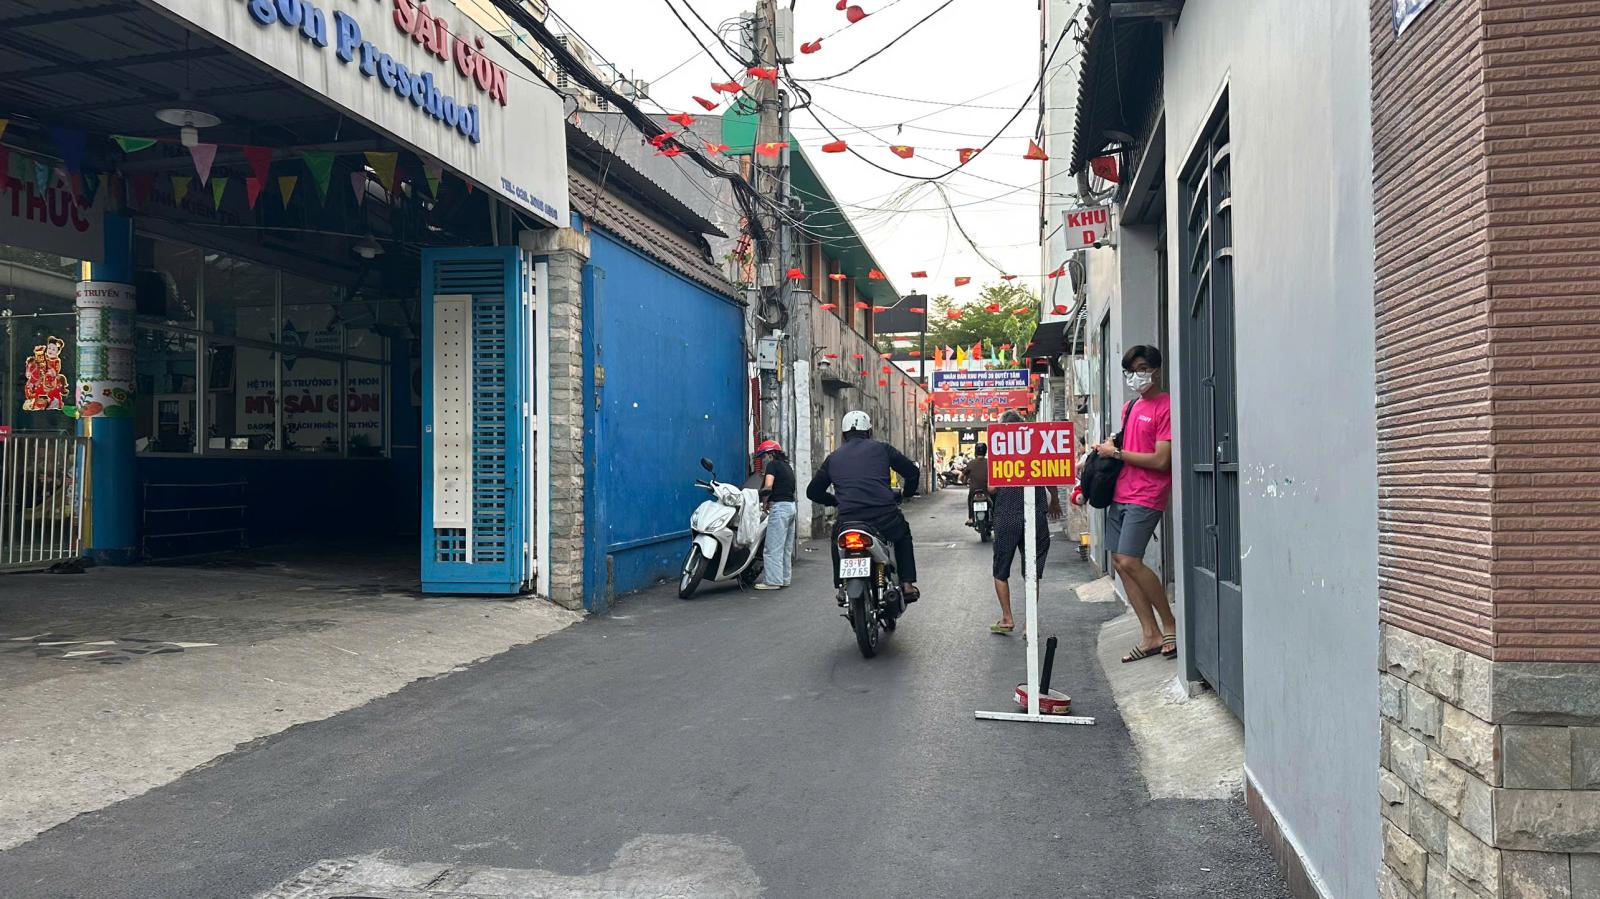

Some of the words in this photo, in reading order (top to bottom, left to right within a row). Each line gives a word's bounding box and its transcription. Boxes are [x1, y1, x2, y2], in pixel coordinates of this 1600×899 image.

[332, 10, 481, 144] Preschool
[452, 34, 509, 108] GÒN
[5, 175, 90, 232] THỨC
[1067, 209, 1107, 228] KHU
[1082, 230, 1096, 245] D
[358, 376, 379, 386] NON
[284, 388, 323, 414] SÀI
[326, 387, 380, 413] GÒN
[991, 425, 1034, 456] GIỮ
[1039, 429, 1071, 454] XE
[992, 459, 1025, 482] HỌC
[1030, 458, 1071, 478] SINH
